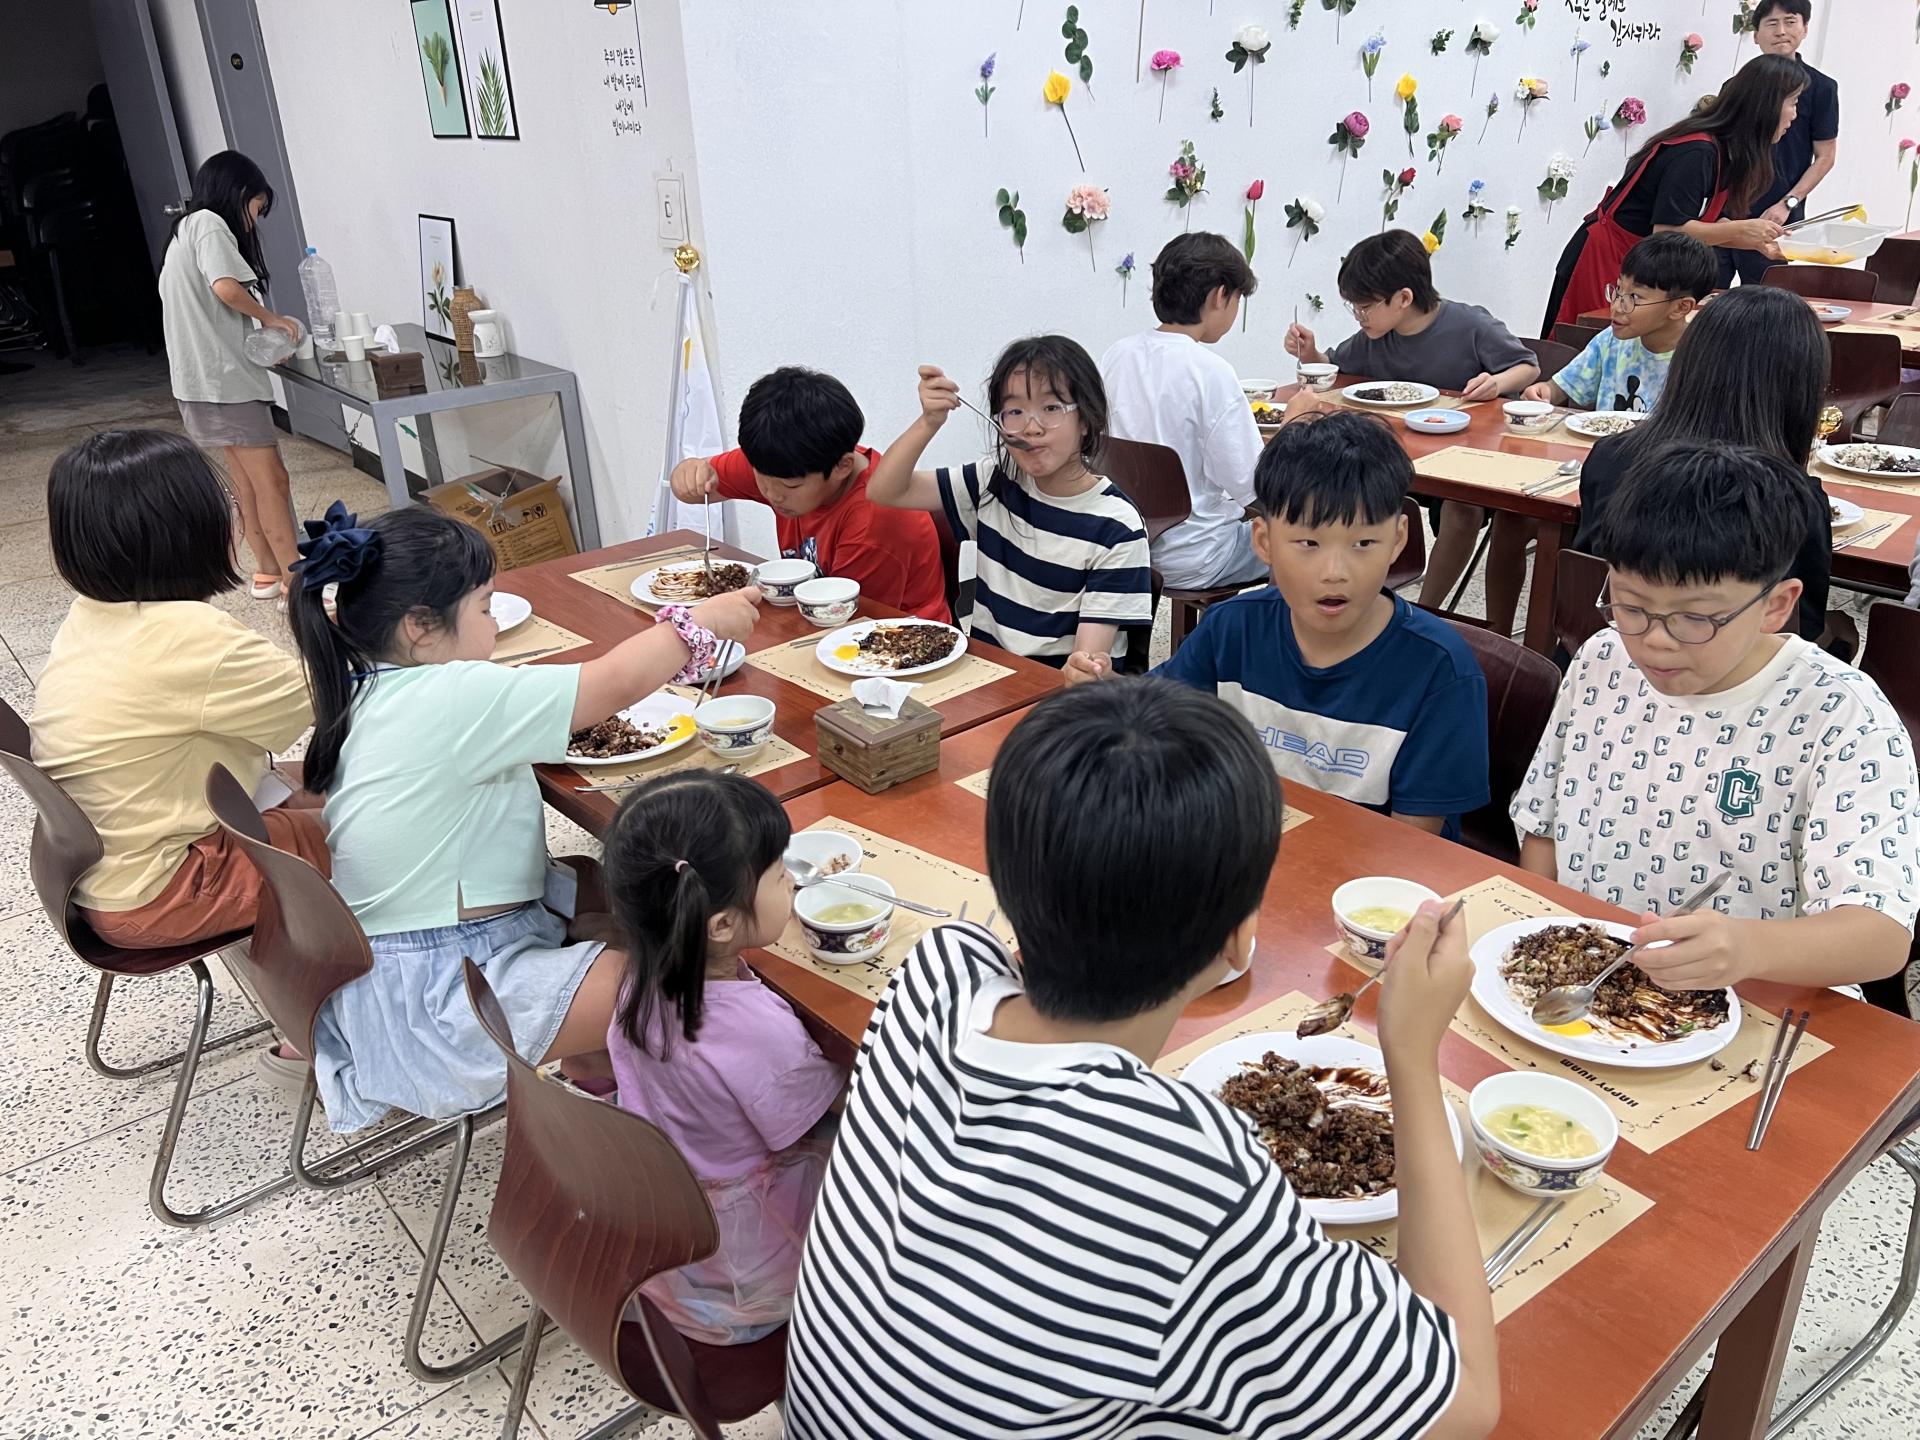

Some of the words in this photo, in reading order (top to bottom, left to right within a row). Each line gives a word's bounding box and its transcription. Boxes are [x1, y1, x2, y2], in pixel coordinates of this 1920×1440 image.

[1257, 726, 1370, 770] HEAD
[1716, 767, 1761, 819] C
[1596, 1081, 1640, 1108] HAPPY
